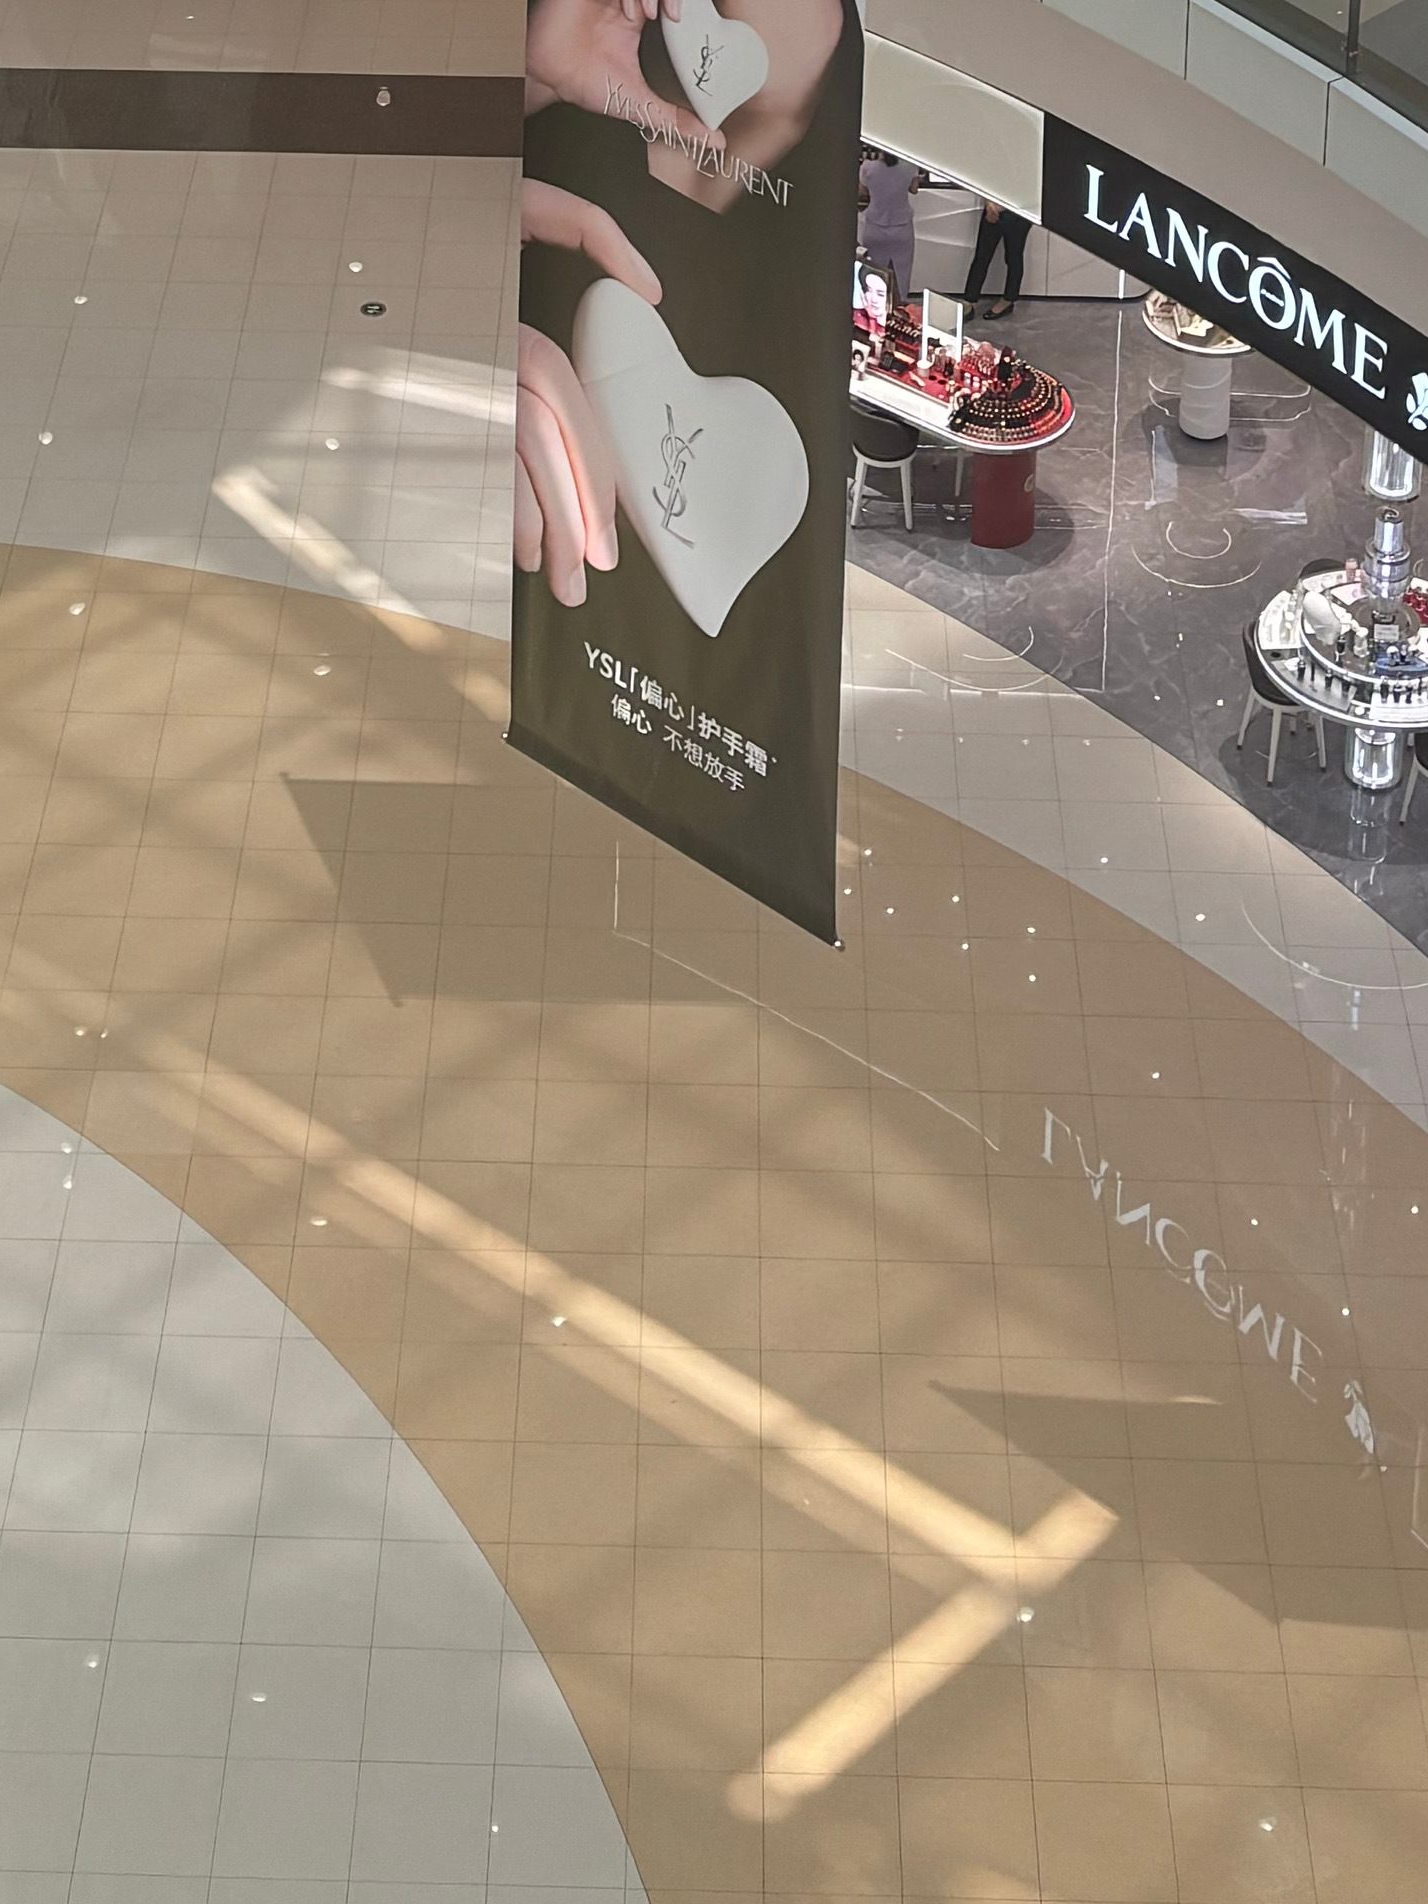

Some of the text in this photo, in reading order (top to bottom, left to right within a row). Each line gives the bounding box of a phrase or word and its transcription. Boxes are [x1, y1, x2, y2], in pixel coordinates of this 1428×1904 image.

[1083, 163, 1389, 399] LANCÔME
[611, 694, 745, 791] 偏心 不想放手
